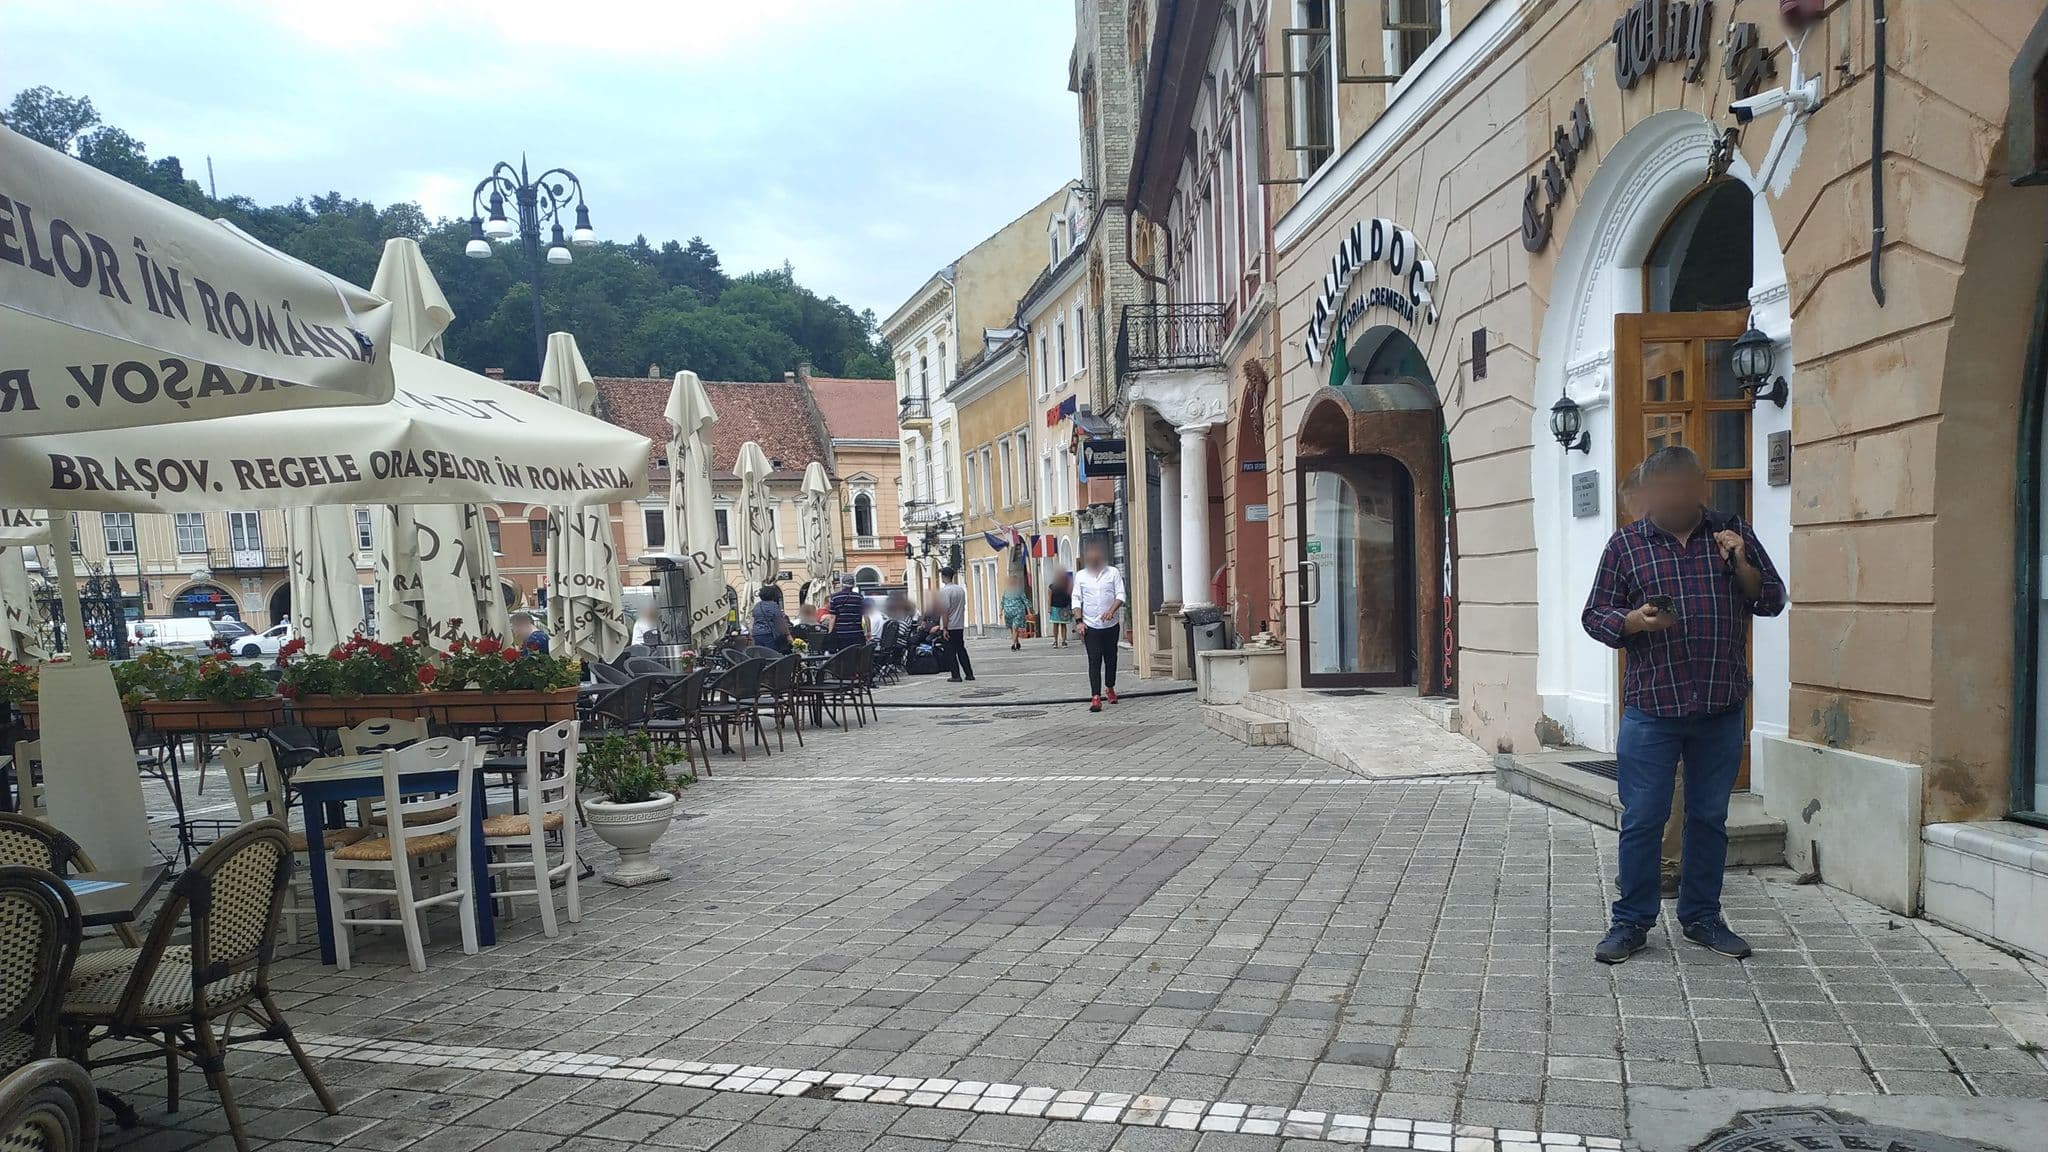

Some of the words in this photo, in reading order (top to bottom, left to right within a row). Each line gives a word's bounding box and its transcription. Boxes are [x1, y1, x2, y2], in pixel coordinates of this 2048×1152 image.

[133, 235, 193, 326] ÎN
[1370, 287, 1414, 328] CREMERIA
[393, 388, 528, 424] ADT
[48, 453, 224, 500] BRAȘOV.
[231, 454, 361, 491] REGELE
[369, 448, 497, 485] ORAȘELOR
[495, 455, 525, 489] ÎN
